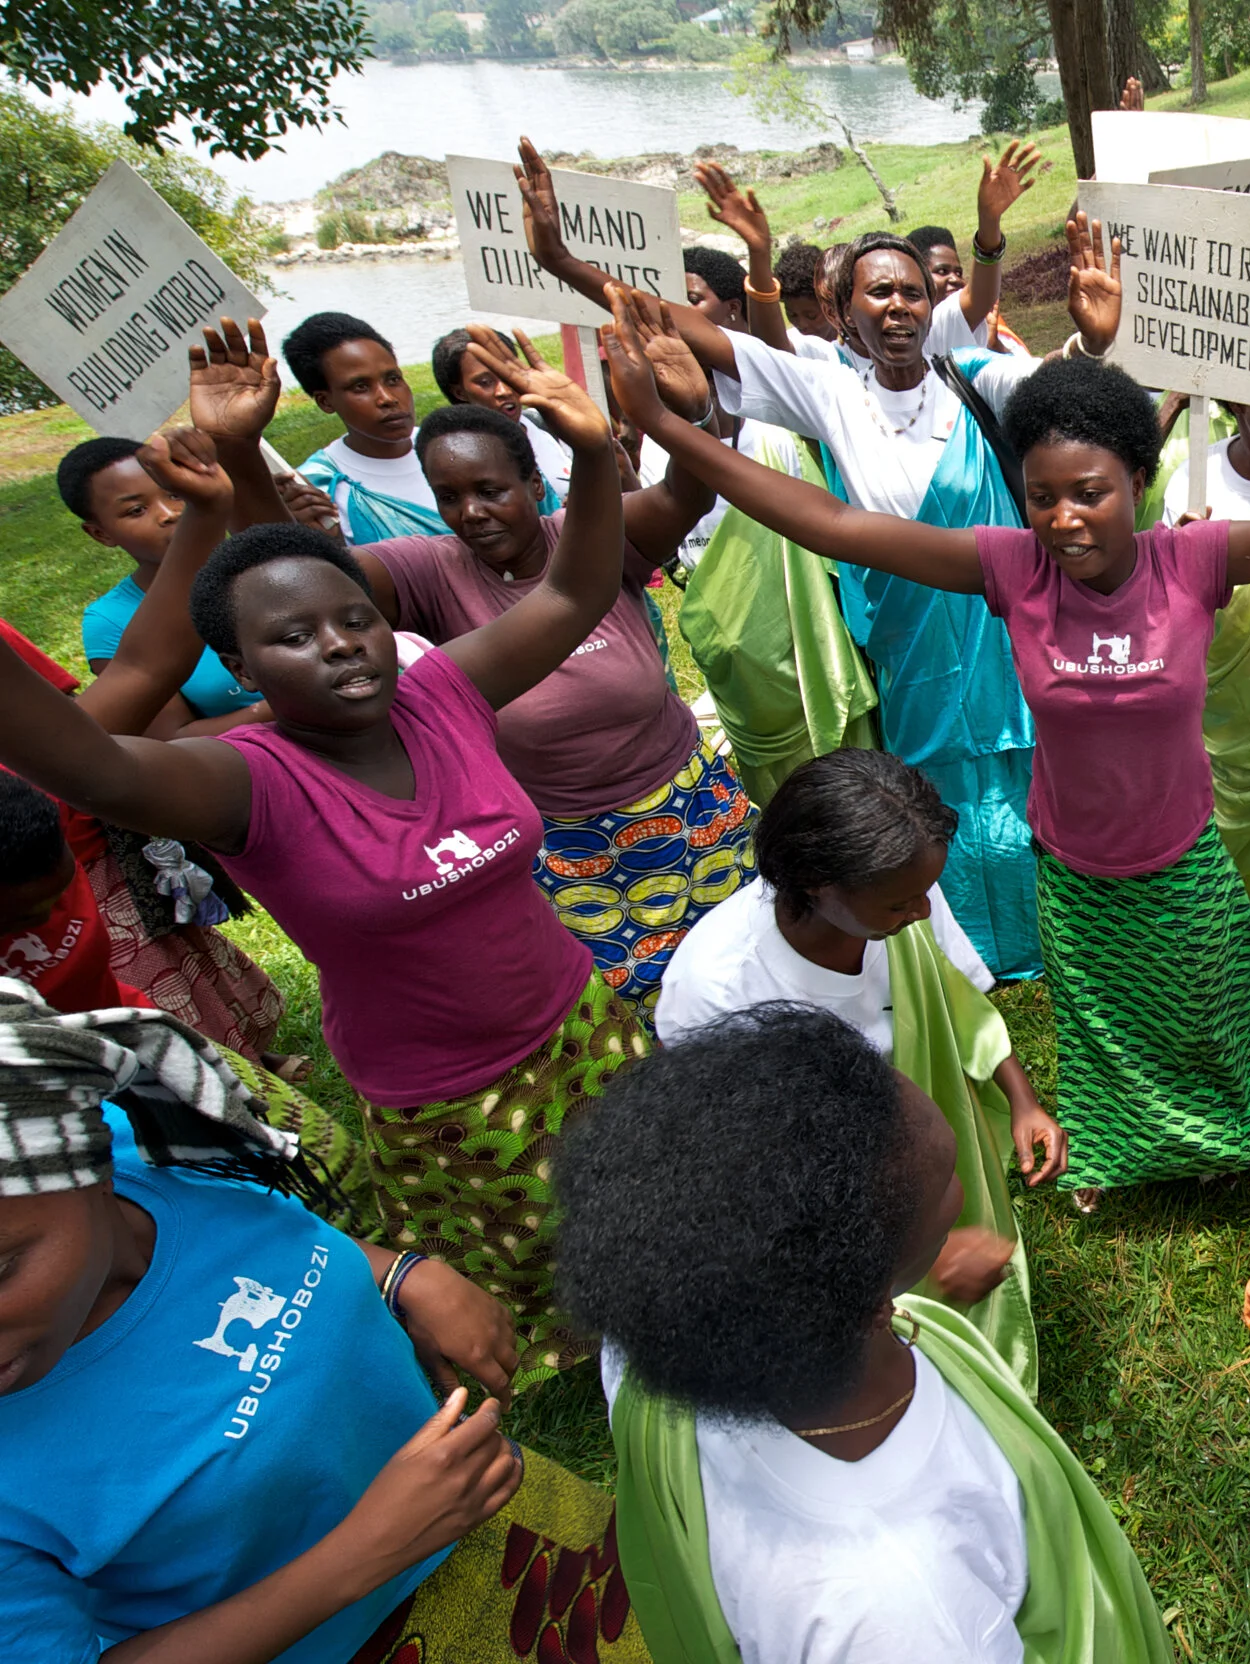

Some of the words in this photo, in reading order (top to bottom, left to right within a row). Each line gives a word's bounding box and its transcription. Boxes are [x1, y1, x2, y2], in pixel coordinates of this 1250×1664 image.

[466, 189, 514, 234] WE
[560, 201, 647, 252] MAND
[1107, 221, 1139, 258] WE
[1143, 227, 1198, 271] WANT
[1206, 239, 1232, 276] TO
[44, 248, 131, 336] WOMEN
[102, 228, 150, 279] IN
[143, 258, 226, 340] WORLD
[480, 246, 545, 291] OUR
[1053, 657, 1165, 675] UBUSHOBOZI
[402, 827, 521, 901] UBUSHOBOZI
[223, 1244, 330, 1440] UBUSHOBOZI
